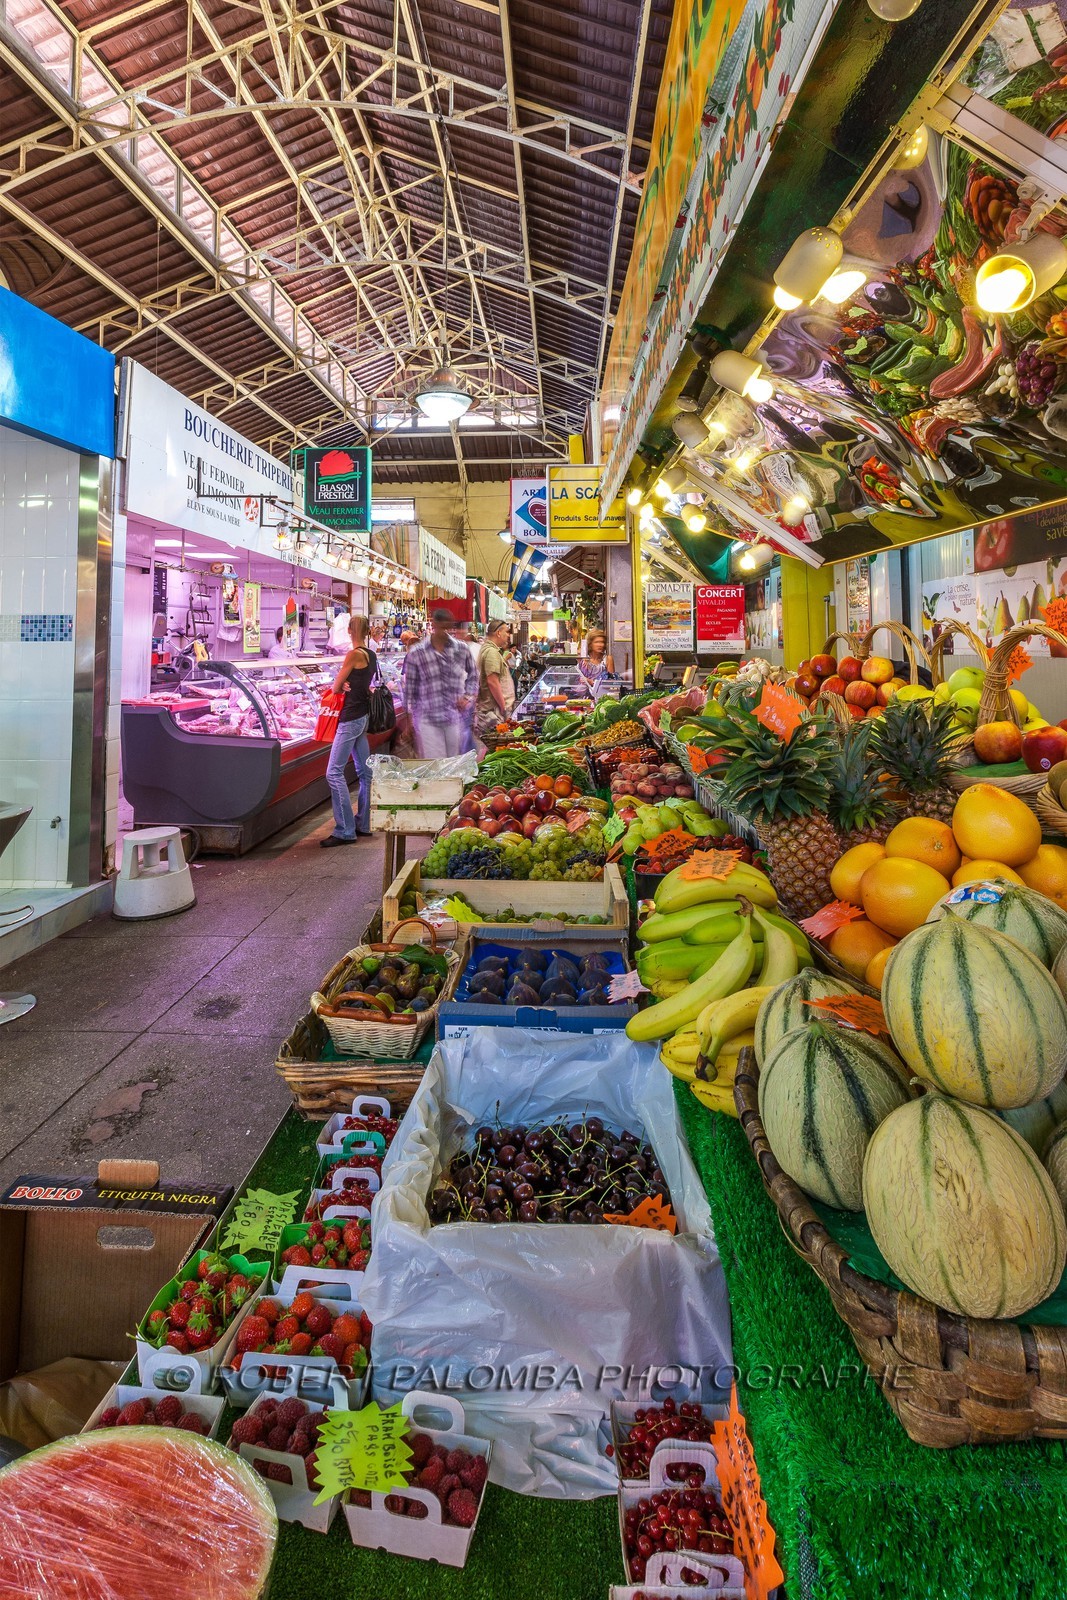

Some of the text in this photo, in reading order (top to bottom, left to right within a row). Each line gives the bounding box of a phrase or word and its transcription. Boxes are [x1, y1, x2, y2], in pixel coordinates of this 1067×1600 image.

[184, 408, 254, 470] BOUCHERIE
[255, 454, 295, 493] TRIPERIE
[183, 450, 245, 495] VEU FERMIER
[202, 482, 242, 512] LIMOUSIN
[318, 484, 355, 500] BLASON PRESTIGE
[551, 487, 569, 500] LA
[333, 507, 365, 515] FERMIER
[647, 583, 691, 593] DEMARTE
[698, 587, 744, 598] CONCERT
[9, 1186, 217, 1205] BOLLO ETIQUETA NEGRA
